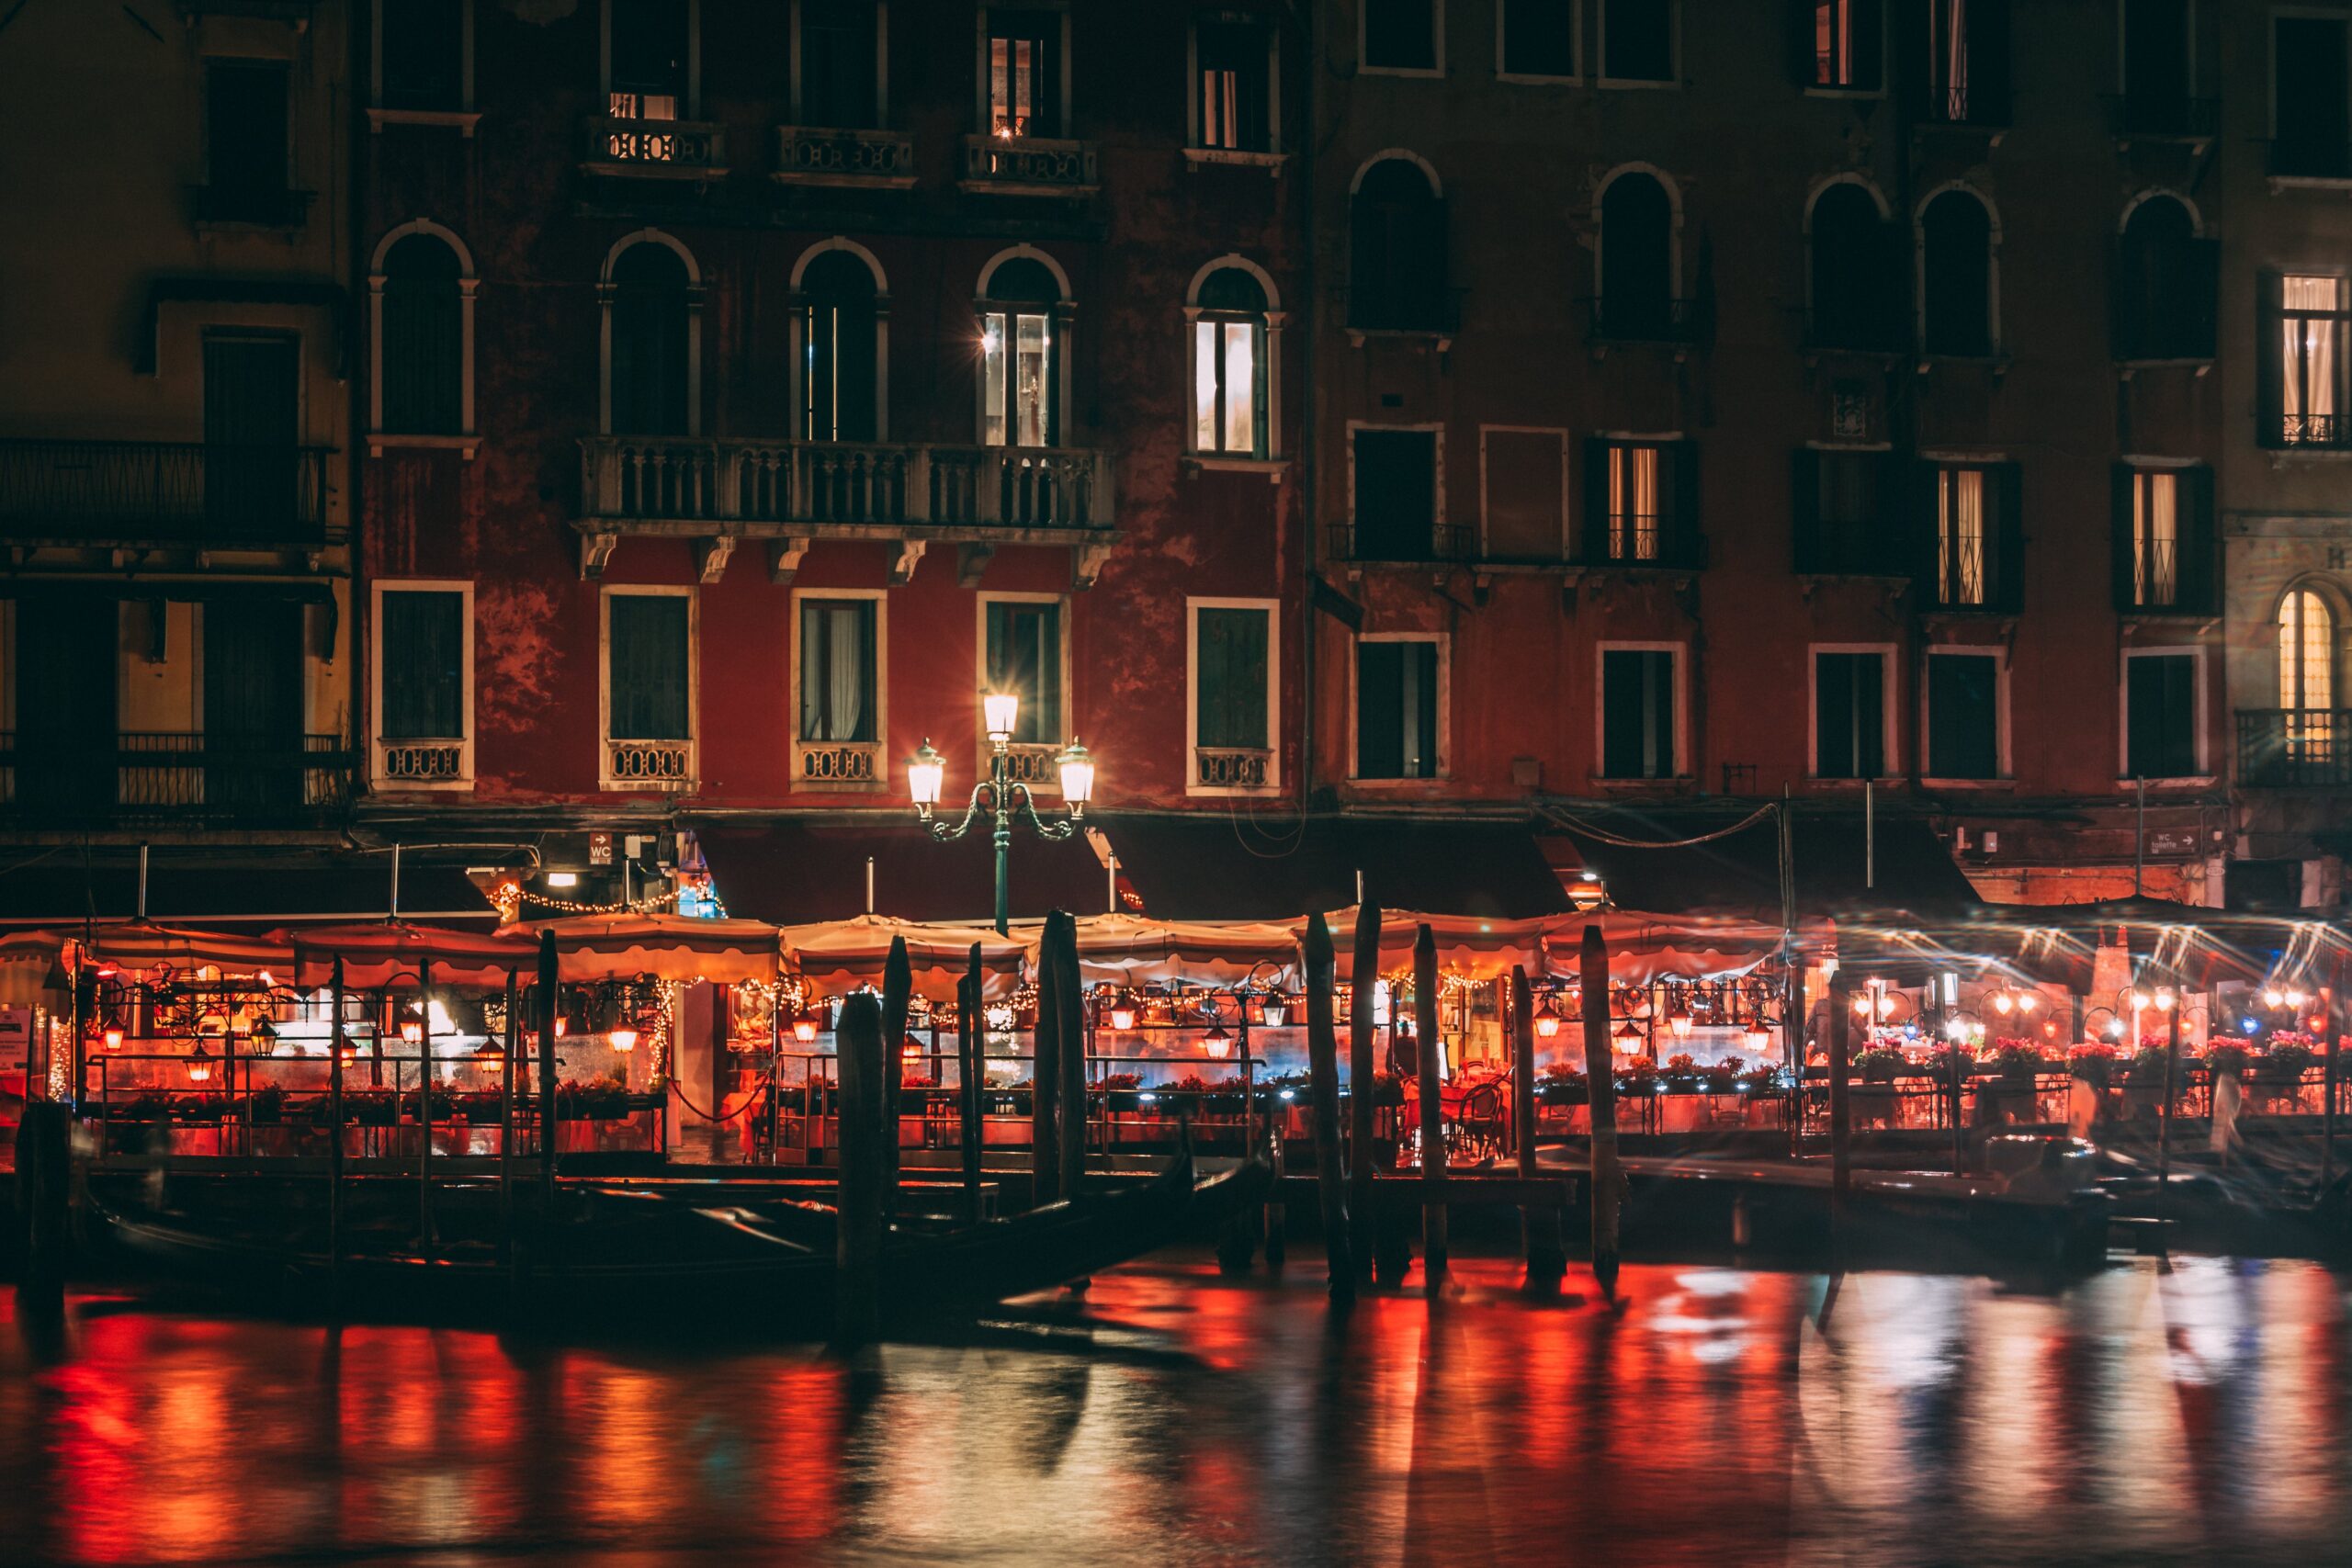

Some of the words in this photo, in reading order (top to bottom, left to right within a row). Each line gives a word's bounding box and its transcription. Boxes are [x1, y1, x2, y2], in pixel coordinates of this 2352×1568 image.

[2157, 833, 2170, 841] WC
[2151, 840, 2177, 849] toilette
[591, 846, 611, 857] WC
